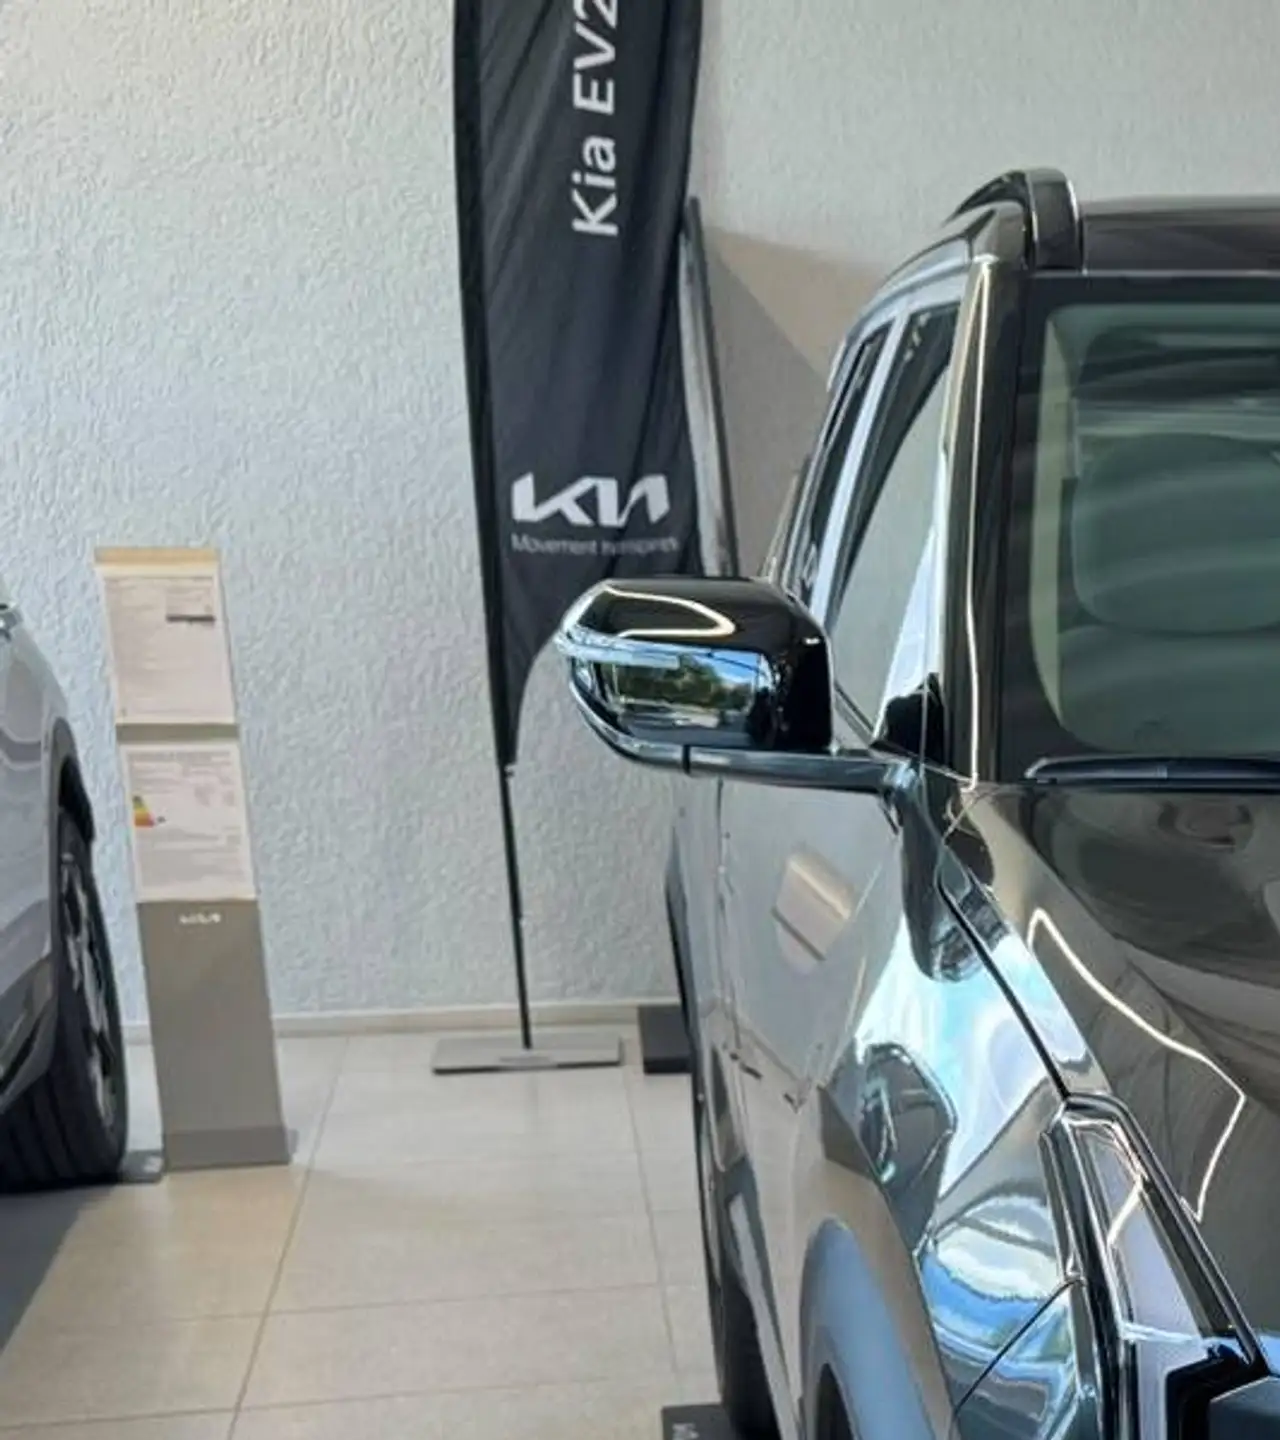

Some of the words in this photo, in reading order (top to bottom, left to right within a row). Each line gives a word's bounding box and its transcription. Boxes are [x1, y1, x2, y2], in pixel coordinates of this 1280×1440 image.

[572, 0, 619, 115] EV2
[571, 135, 619, 237] Kia
[512, 471, 670, 528] KIA
